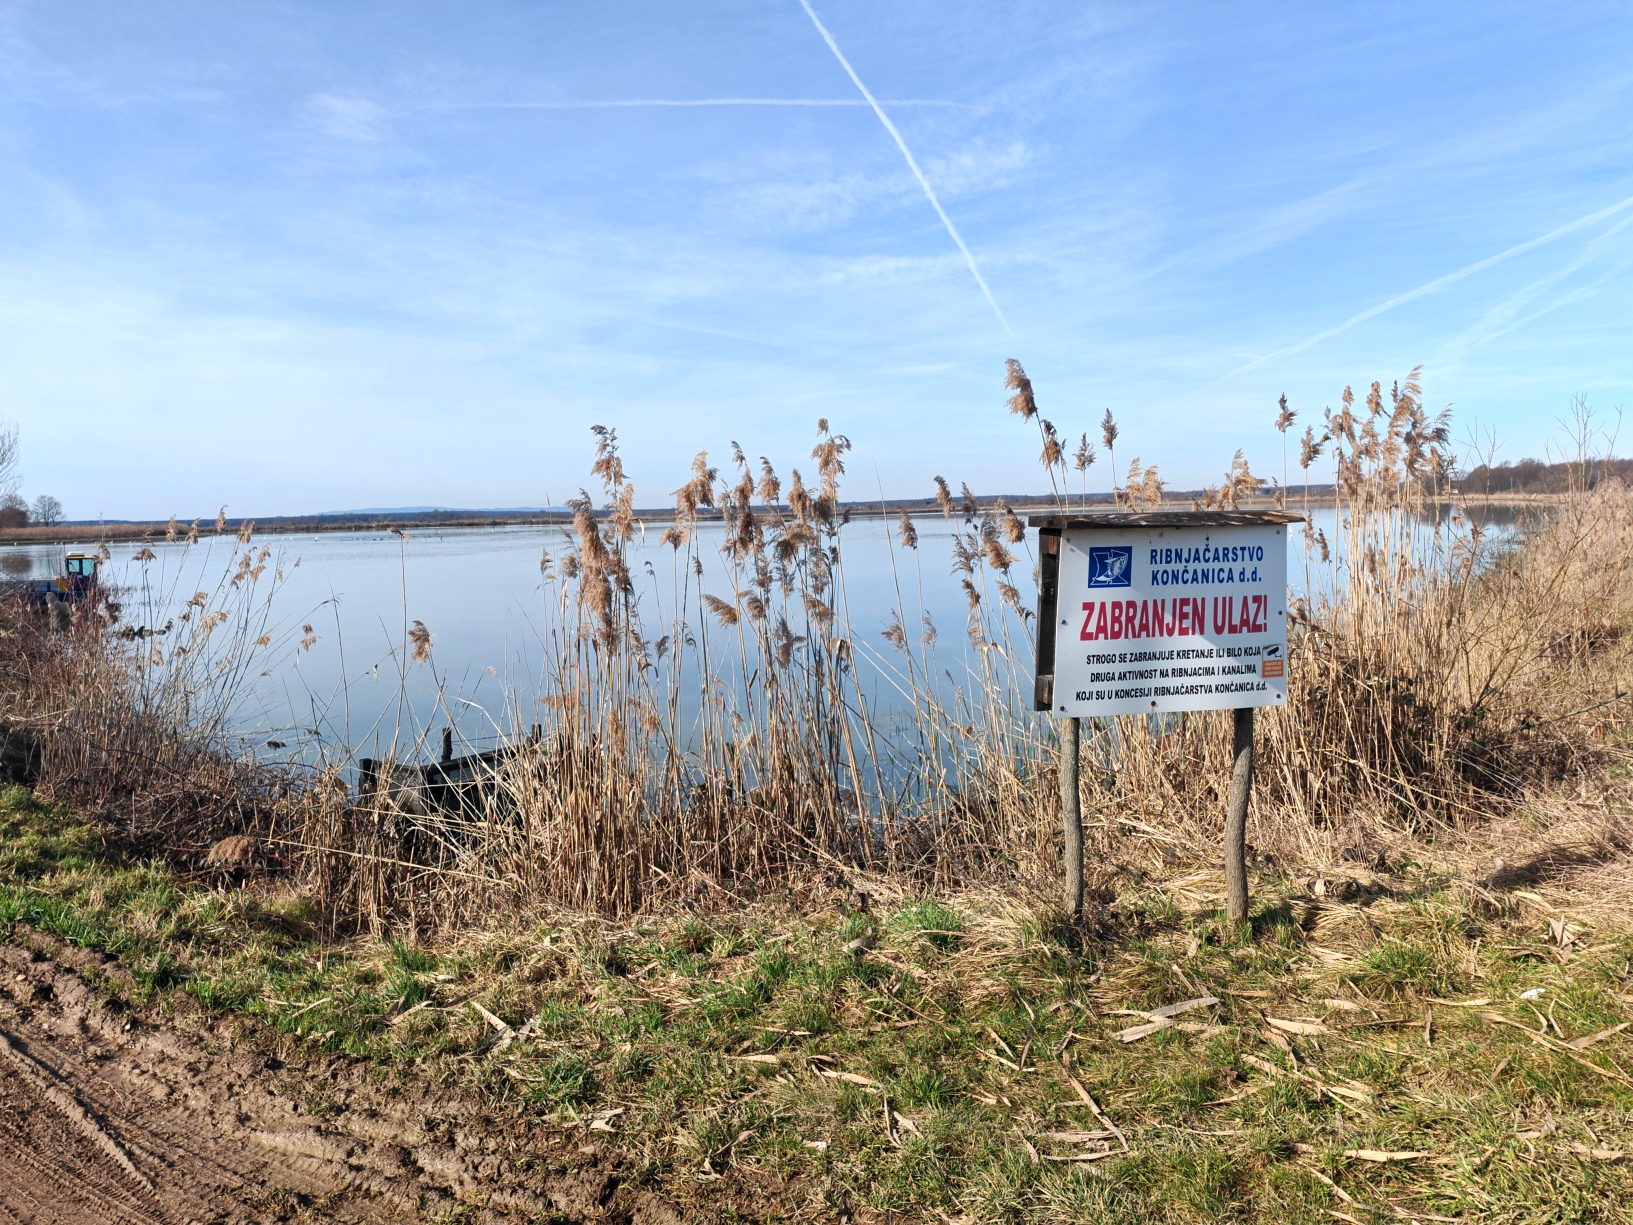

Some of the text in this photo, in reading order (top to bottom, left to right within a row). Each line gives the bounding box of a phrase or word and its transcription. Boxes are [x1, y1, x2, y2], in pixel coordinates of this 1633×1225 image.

[1150, 544, 1264, 564] RIBNJAČARSTVO
[1151, 565, 1262, 586] KONČANICA d.d.
[1080, 594, 1268, 641] ZABRANJEN ULAZ!
[1086, 646, 1261, 665] STROGO SE ZABRANJUJE KRETANJE ILI BILO KOJA
[1090, 672, 1116, 682] DRUGA
[1117, 669, 1158, 682] AKTIVNOST
[1160, 668, 1170, 678] NA
[1171, 666, 1216, 678] RIBNJACIMA
[1217, 666, 1220, 676] I
[1222, 664, 1256, 676] KANALIMA
[1076, 681, 1268, 702] KOJI SU U KONCESIJI RIBNJAČARSTVA KONČANICA d.d.
